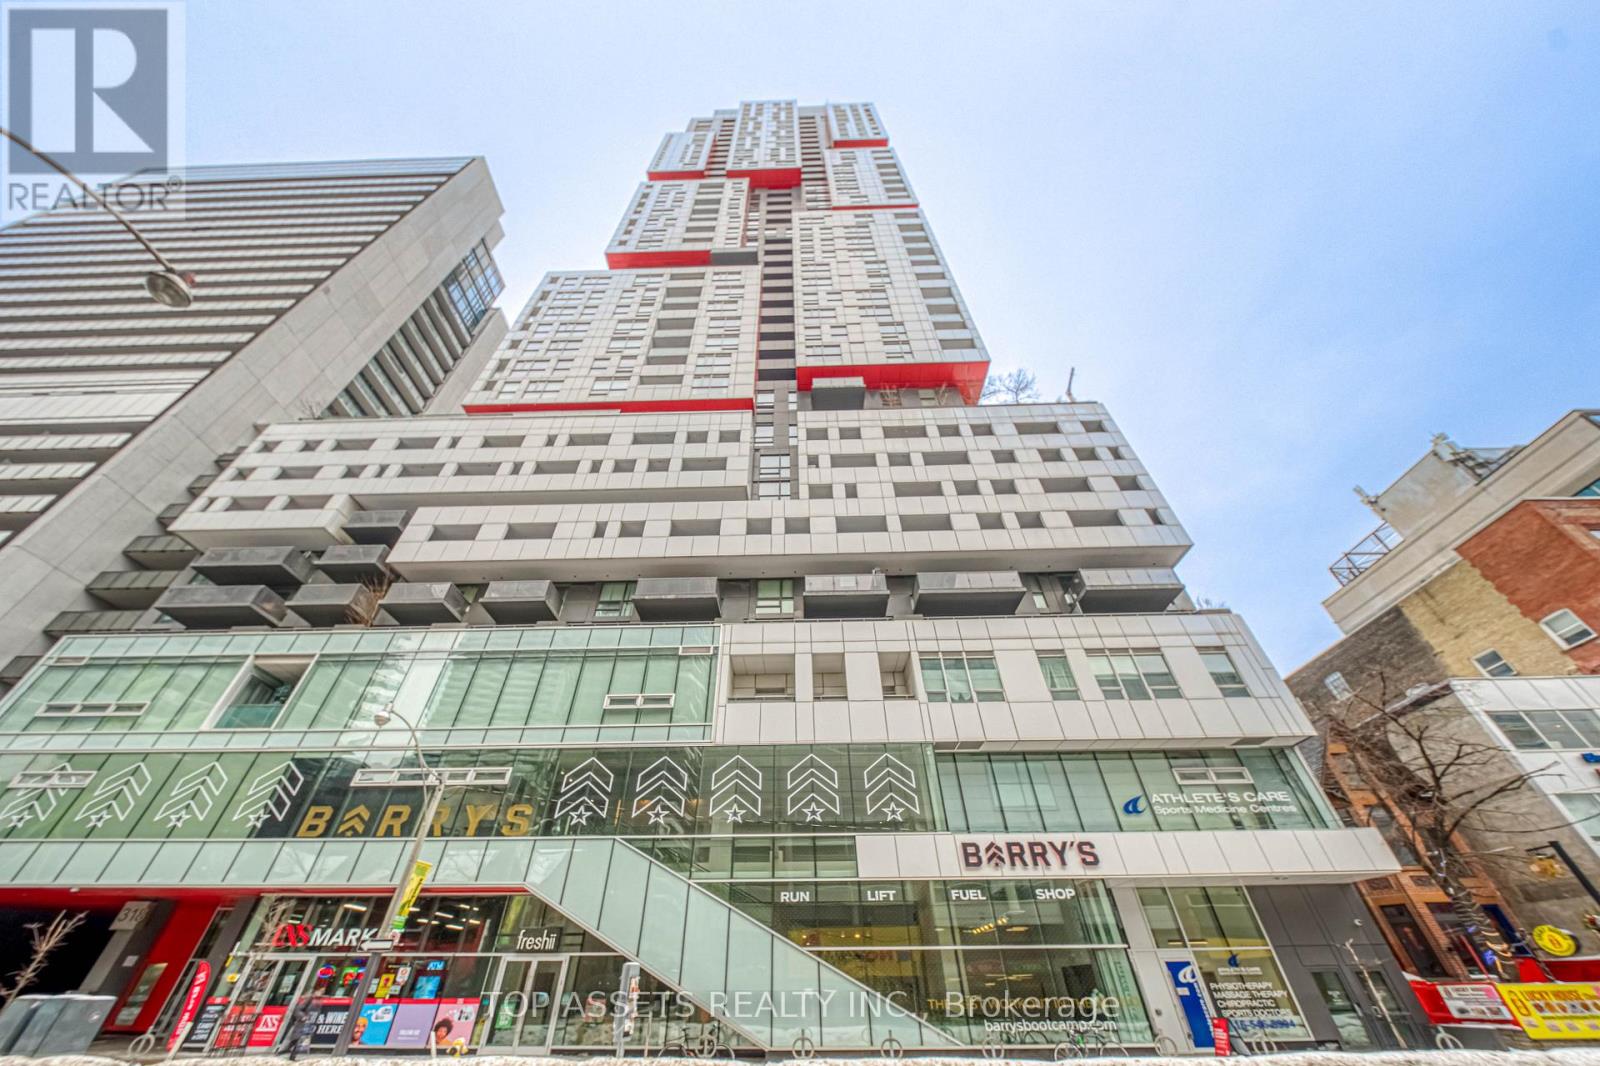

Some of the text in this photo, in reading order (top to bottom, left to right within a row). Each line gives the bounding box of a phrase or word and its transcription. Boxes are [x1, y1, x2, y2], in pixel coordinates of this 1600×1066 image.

[1152, 791, 1290, 804] ATHLETE'S CARE
[1154, 803, 1297, 815] Sports Medicine Centres
[780, 888, 1076, 902] RUN LIFT FUEL SHOP
[516, 929, 557, 950] freshii
[1209, 982, 1272, 991] PHYSIOTHERAPY
[1213, 990, 1288, 999] MASSAGE THERAPY
[1216, 999, 1276, 1008] CHIROPRACTIC
